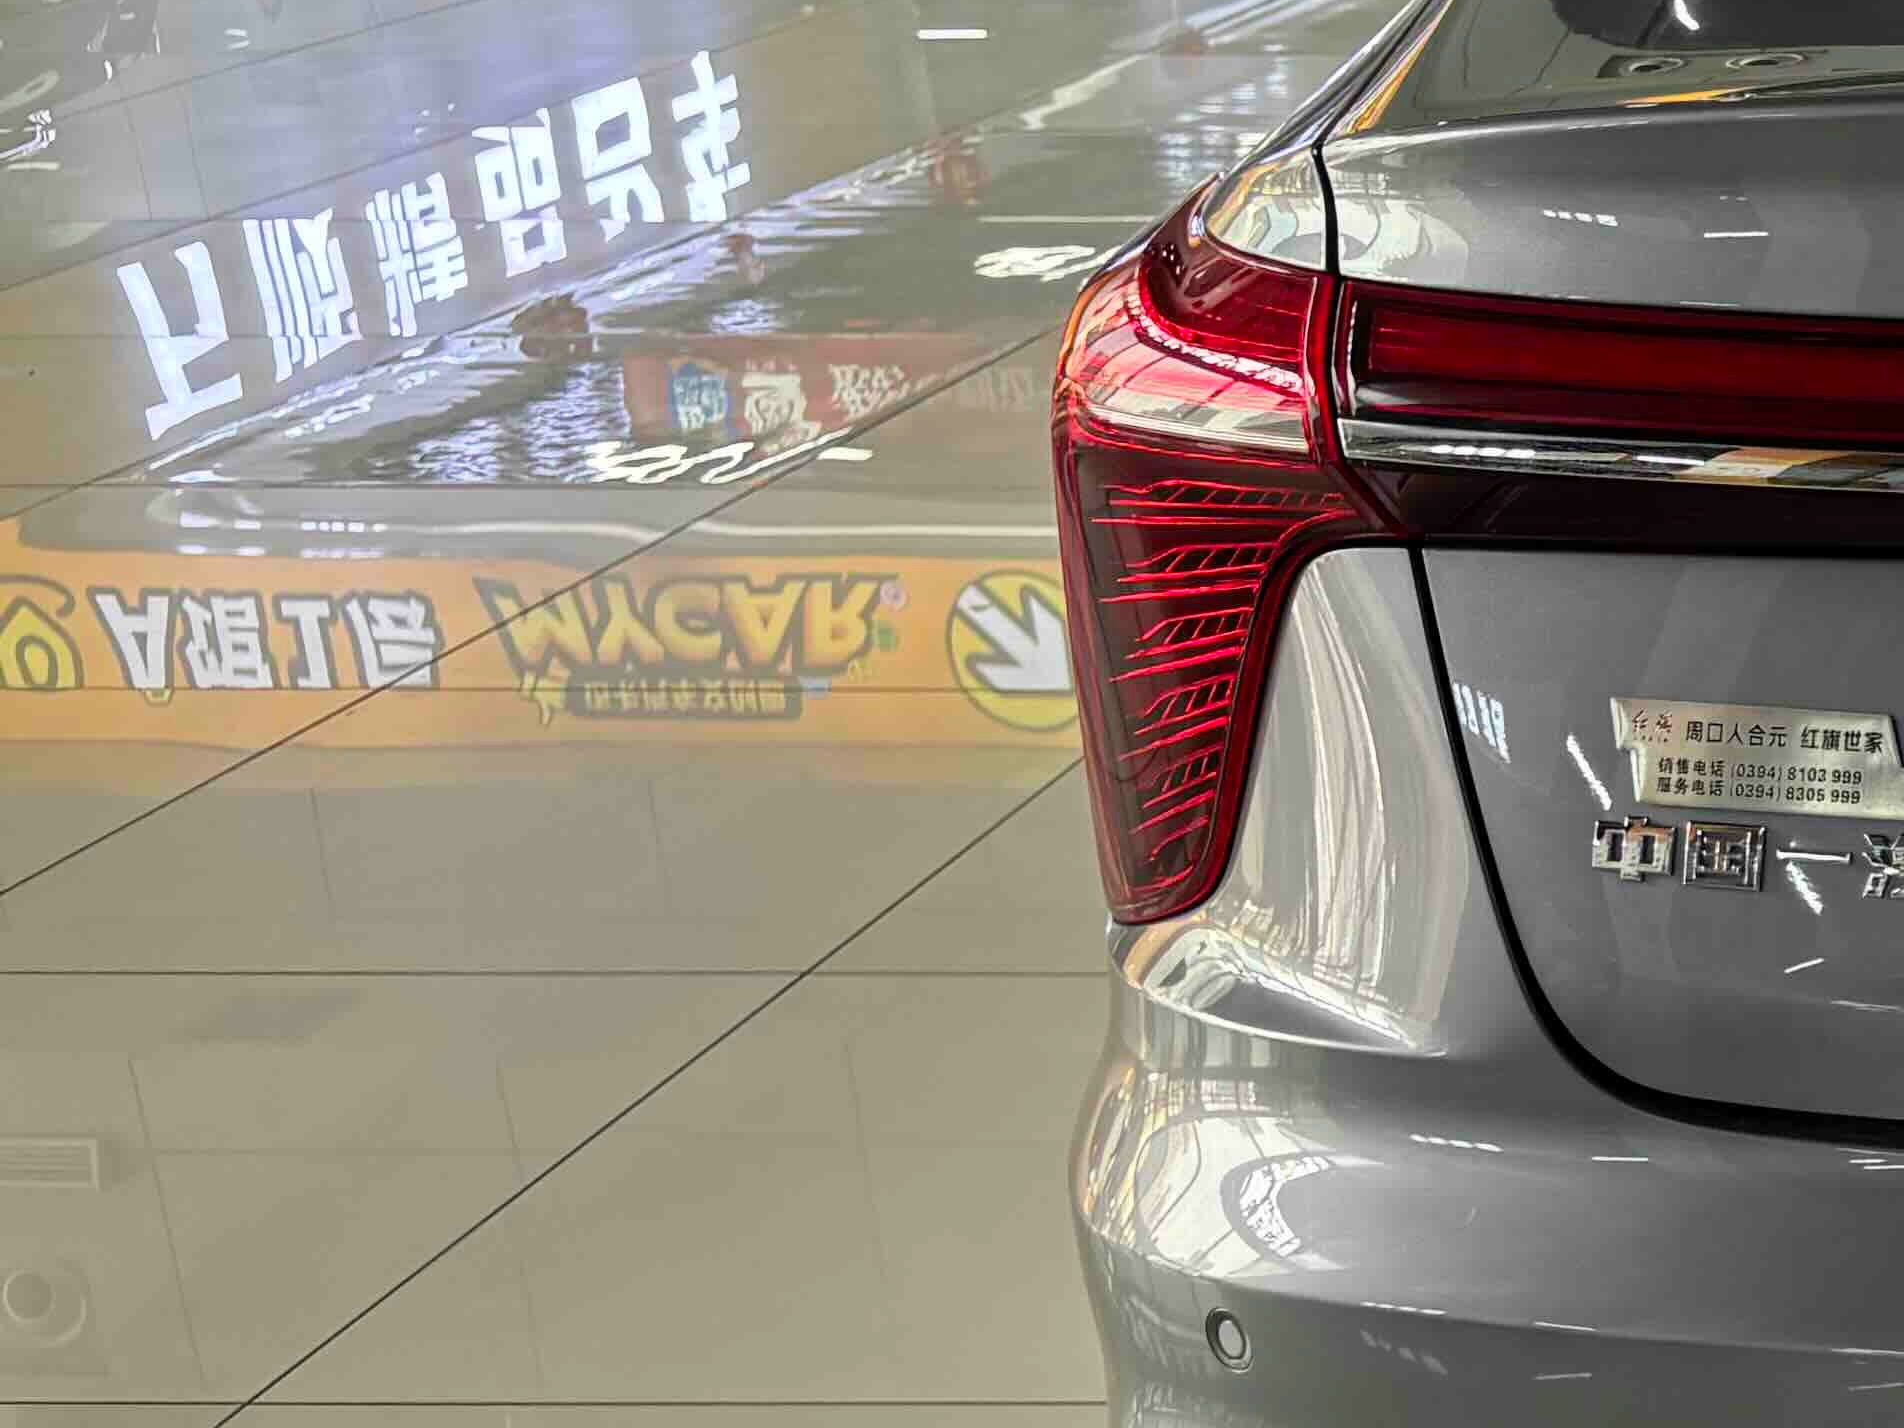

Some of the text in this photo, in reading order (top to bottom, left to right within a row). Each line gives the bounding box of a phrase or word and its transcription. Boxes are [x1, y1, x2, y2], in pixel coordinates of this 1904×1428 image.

[1685, 720, 1788, 748] 周口人合元
[1799, 725, 1885, 754] 红旗世家
[1657, 756, 1727, 778] 销售电话
[1656, 776, 1726, 798] 服务电话
